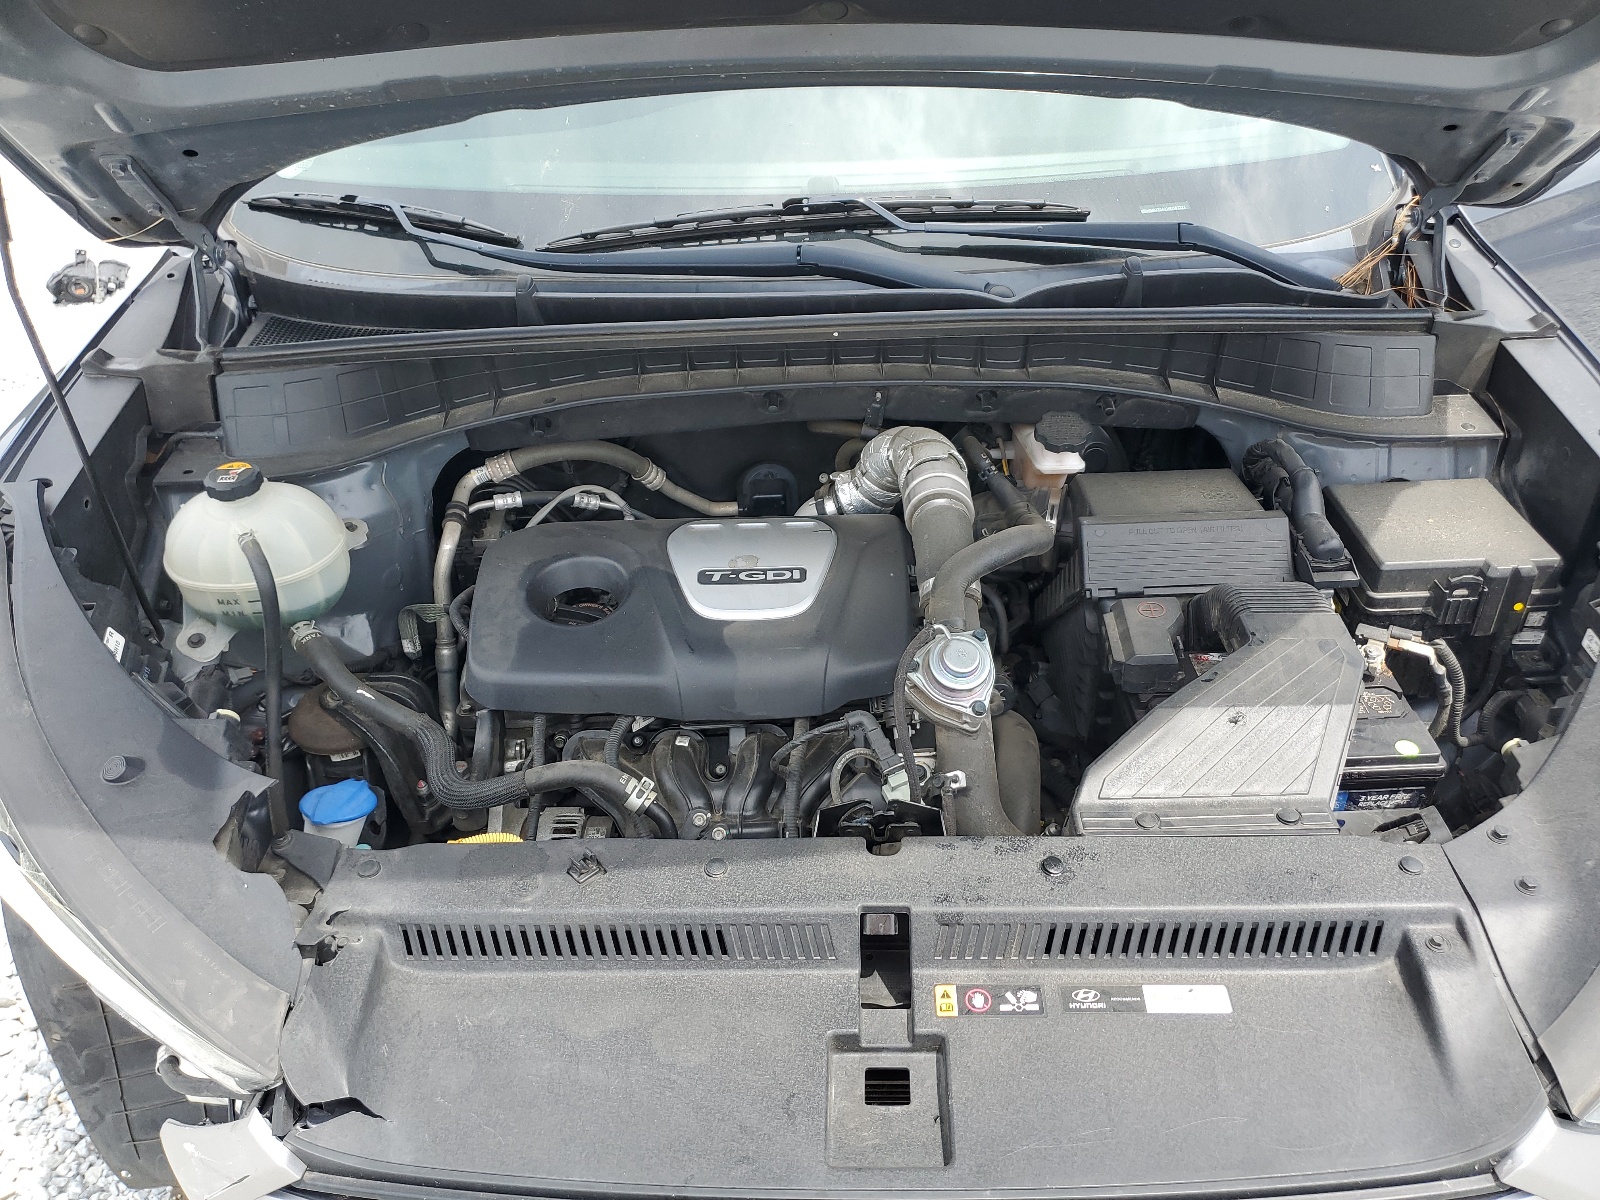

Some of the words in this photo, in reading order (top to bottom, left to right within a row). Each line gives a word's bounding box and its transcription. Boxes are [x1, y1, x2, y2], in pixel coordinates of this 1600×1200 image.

[705, 569, 801, 582] T-GDI
[216, 598, 241, 606] MAX
[300, 632, 322, 645] TANK
